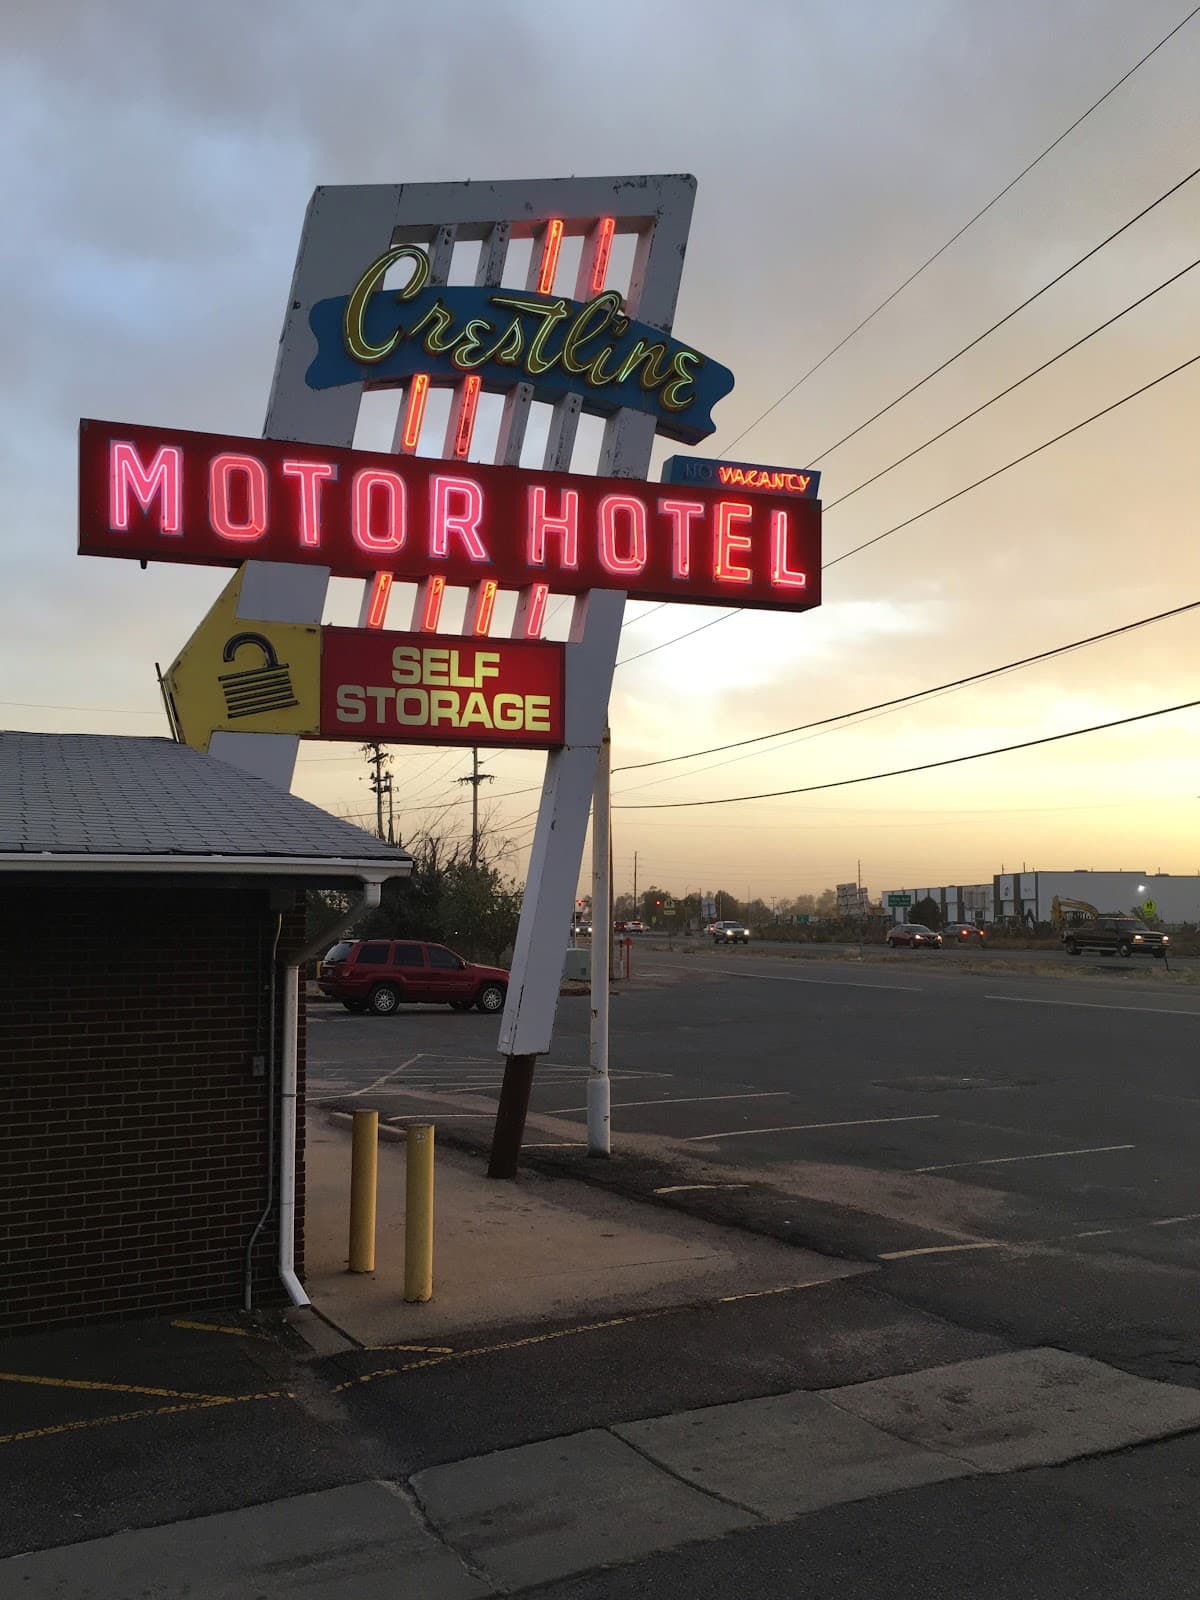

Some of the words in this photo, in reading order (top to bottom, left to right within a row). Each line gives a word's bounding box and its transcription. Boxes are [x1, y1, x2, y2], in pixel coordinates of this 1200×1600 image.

[344, 245, 702, 412] Crestline
[685, 463, 712, 481] NO
[719, 466, 811, 491] VACANCY
[109, 440, 492, 563] MOTOR
[526, 484, 807, 590] HOTEL
[391, 646, 500, 688] SELF
[336, 684, 551, 732] STORAGE
